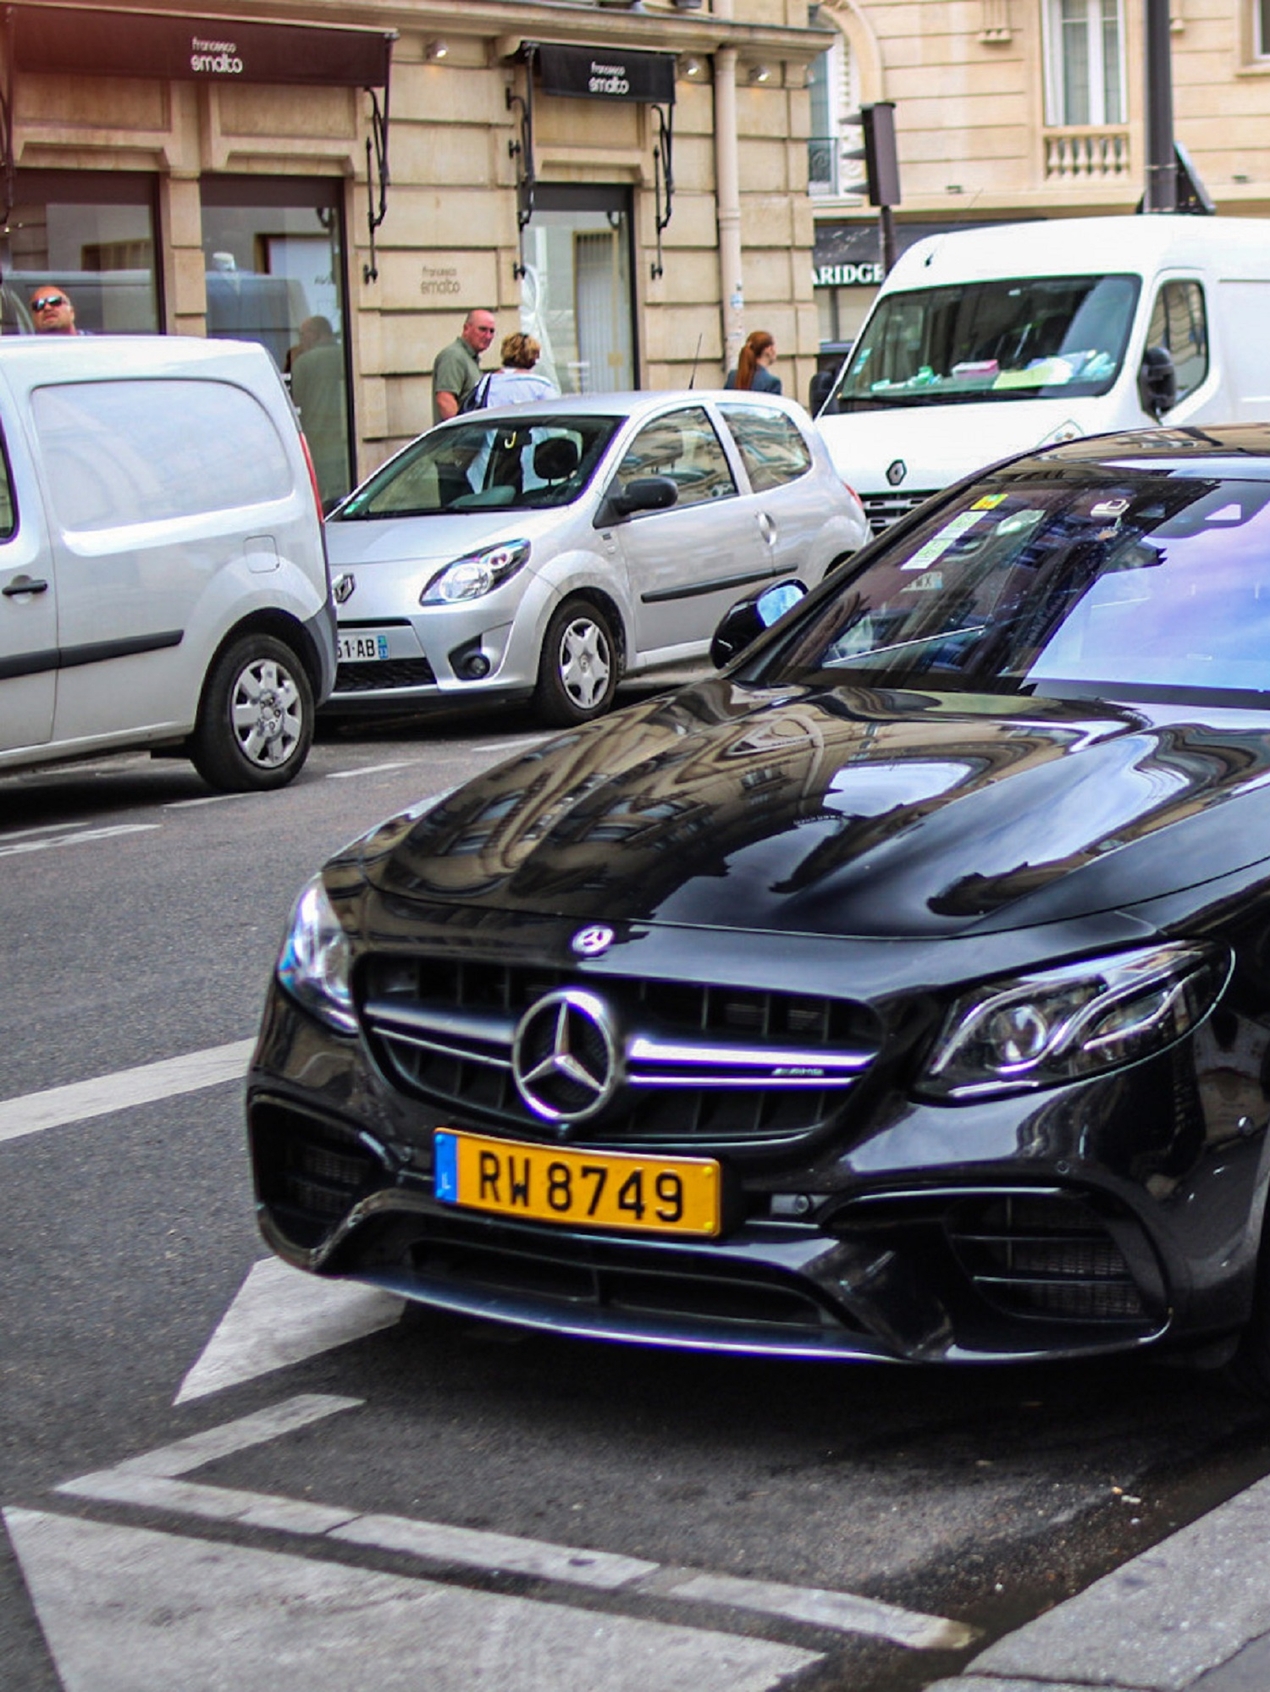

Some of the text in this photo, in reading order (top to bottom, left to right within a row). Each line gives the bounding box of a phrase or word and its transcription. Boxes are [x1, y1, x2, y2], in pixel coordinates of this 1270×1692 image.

[190, 53, 243, 73] smalto
[479, 1150, 684, 1223] RW 8749
